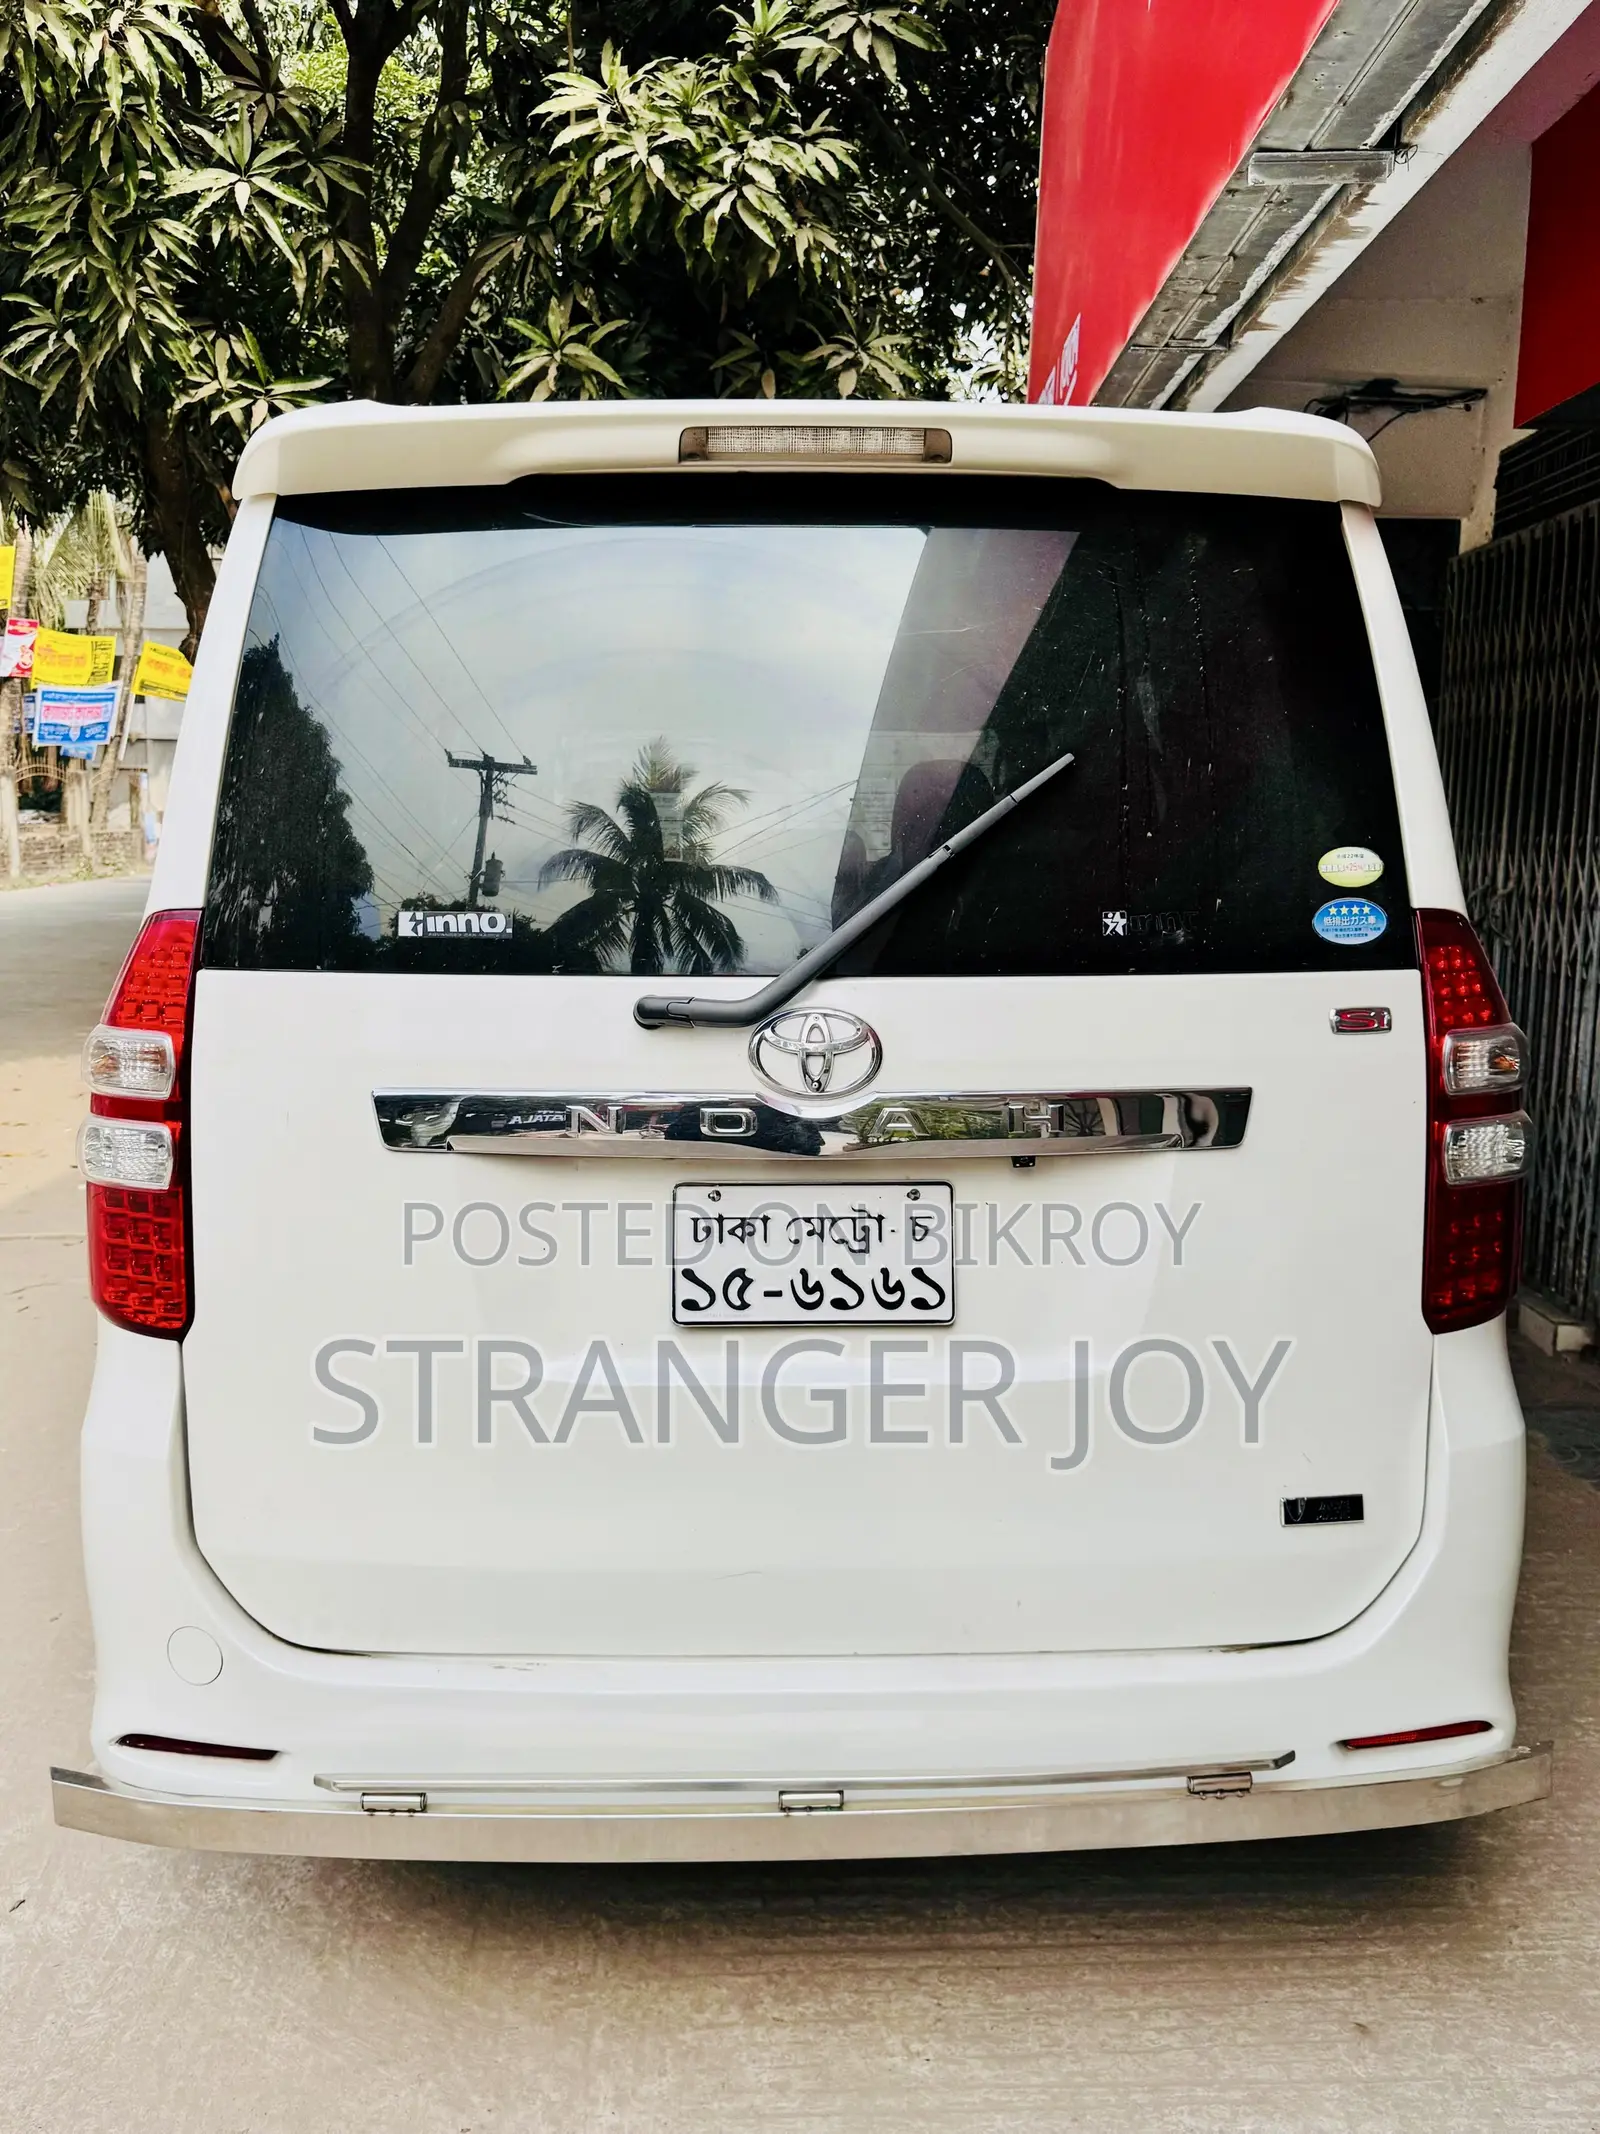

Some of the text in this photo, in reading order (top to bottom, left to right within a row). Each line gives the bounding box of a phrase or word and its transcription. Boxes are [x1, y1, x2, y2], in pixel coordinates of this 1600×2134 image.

[566, 1103, 1064, 1138] NOAH
[689, 1212, 772, 1244] ঢাকা
[680, 1266, 947, 1312] ১৫-৬১৬১
